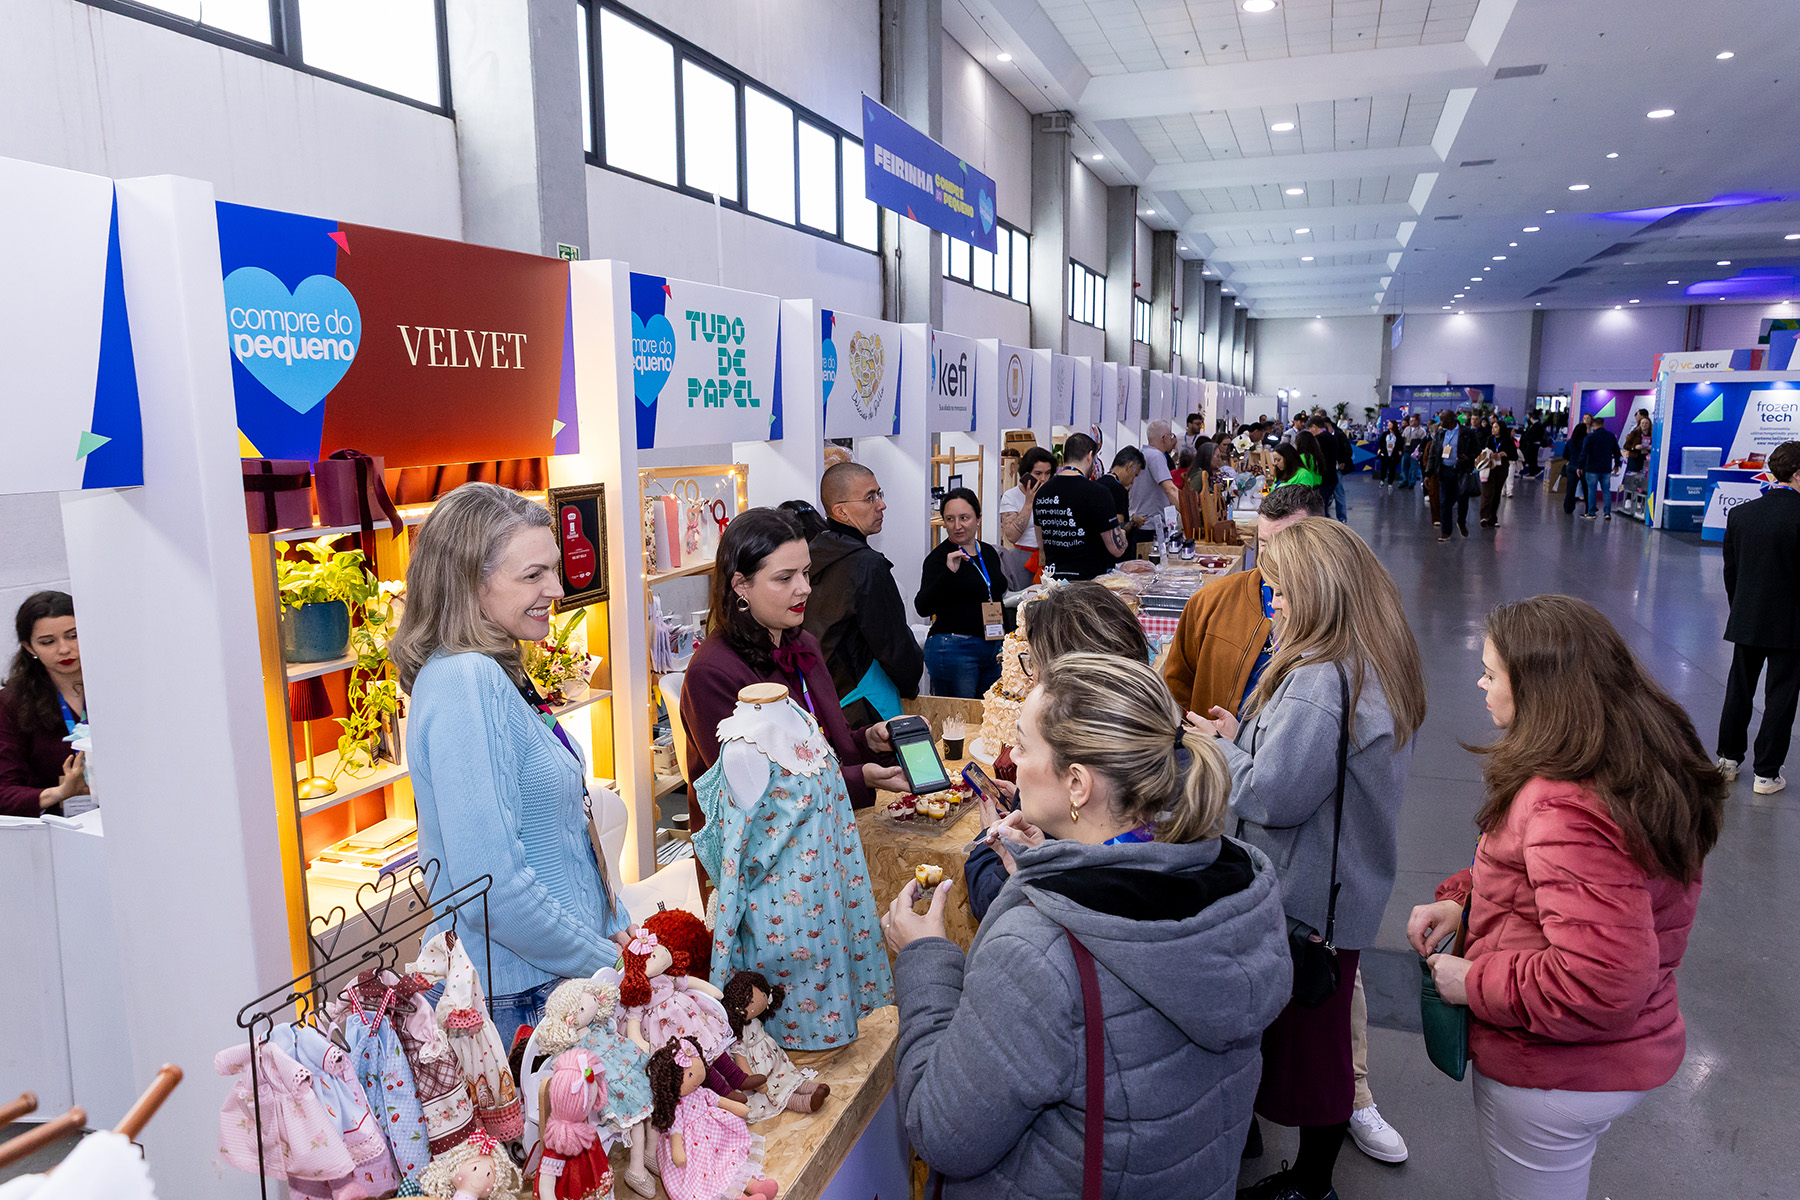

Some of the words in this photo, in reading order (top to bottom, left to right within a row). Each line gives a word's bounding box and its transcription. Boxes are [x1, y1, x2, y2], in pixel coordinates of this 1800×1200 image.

[874, 143, 935, 196] FEIRINHA
[935, 173, 964, 200] COMPRE
[943, 192, 974, 218] PEQUENO
[230, 307, 320, 335] compre
[325, 309, 353, 335] do
[685, 310, 745, 345] TUDO
[234, 333, 355, 366] pequeno
[396, 324, 527, 370] VELVET
[632, 338, 657, 358] mpre
[659, 337, 672, 354] do
[634, 356, 673, 375] queno
[718, 347, 746, 377] DE
[939, 348, 967, 398] kefi
[1680, 361, 1720, 370] VC.autor
[687, 378, 760, 408] PAPEL
[1757, 401, 1798, 412] frozen
[1761, 413, 1792, 423] tech
[1719, 494, 1752, 506] froze
[1069, 518, 1076, 527] &
[1077, 528, 1085, 536] &
